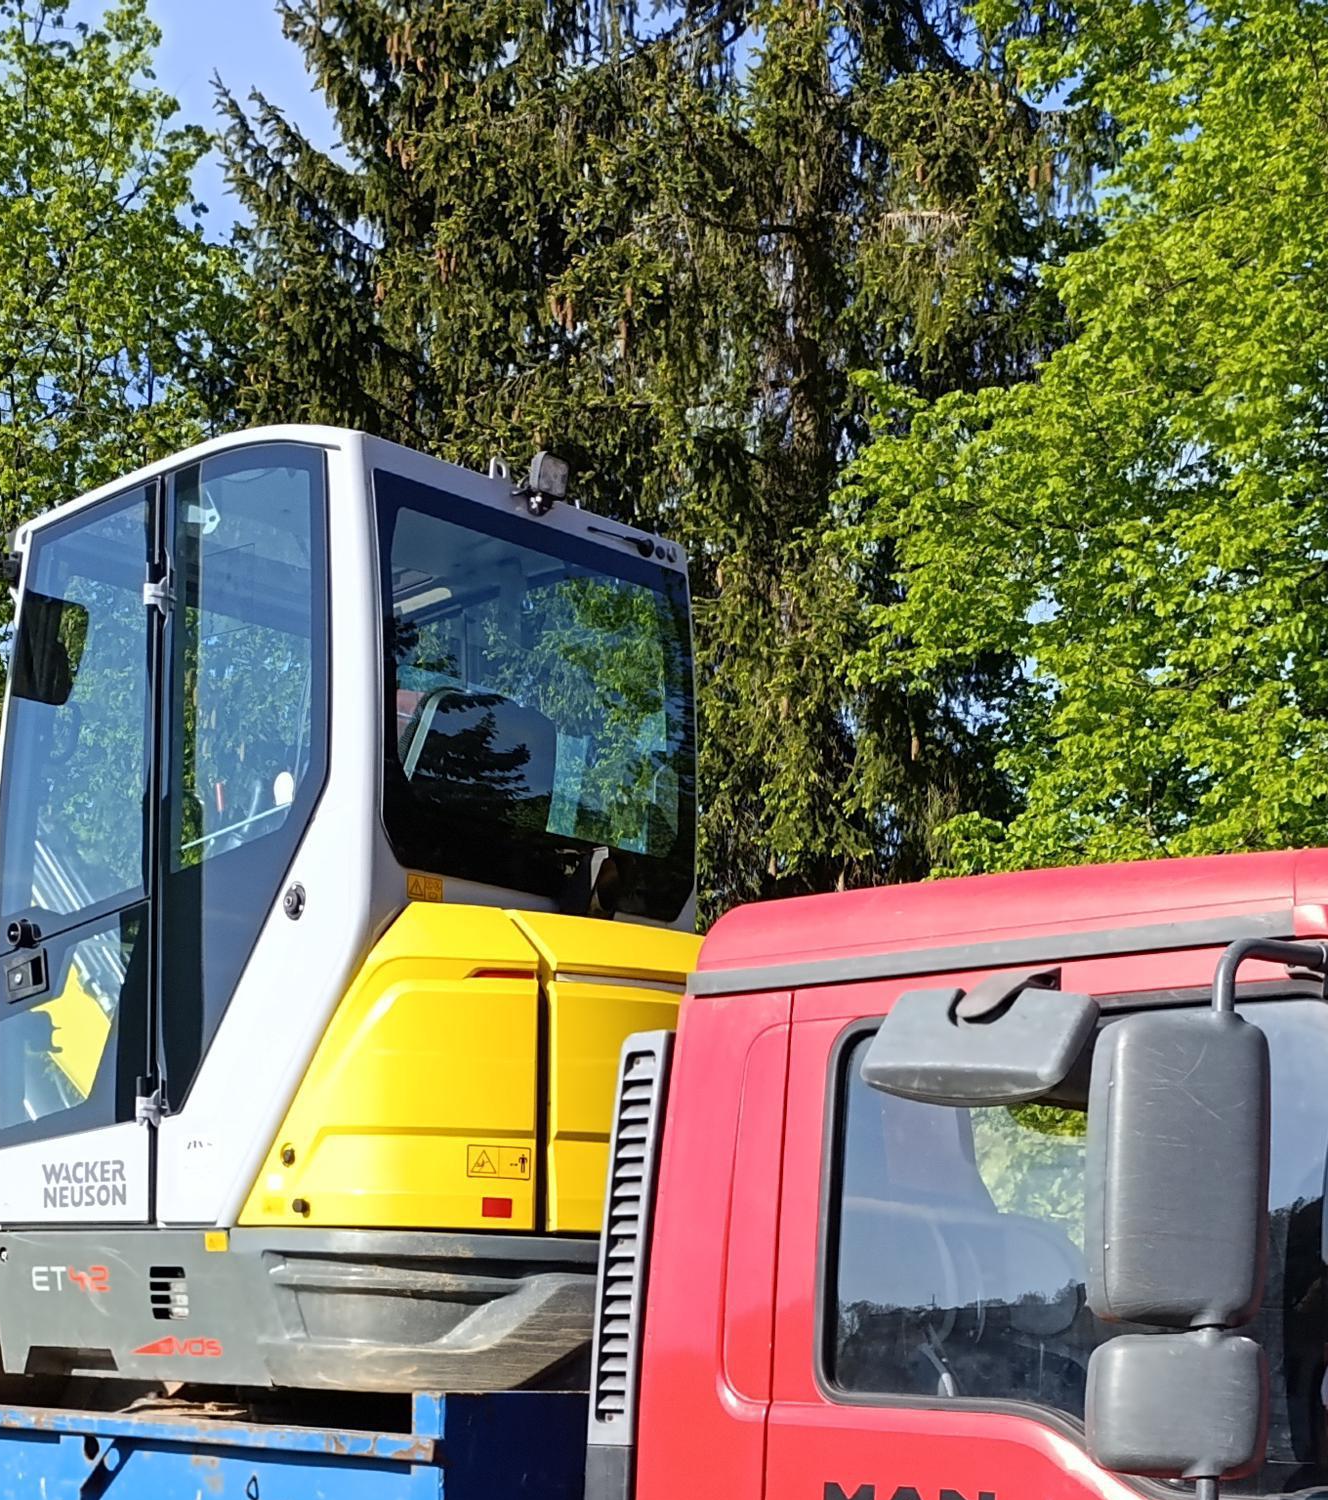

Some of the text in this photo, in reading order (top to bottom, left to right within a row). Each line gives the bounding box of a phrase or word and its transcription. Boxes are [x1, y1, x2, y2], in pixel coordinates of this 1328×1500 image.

[42, 1160, 126, 1184] WACKER
[43, 1184, 127, 1208] NEUSON
[32, 1265, 111, 1292] ET42
